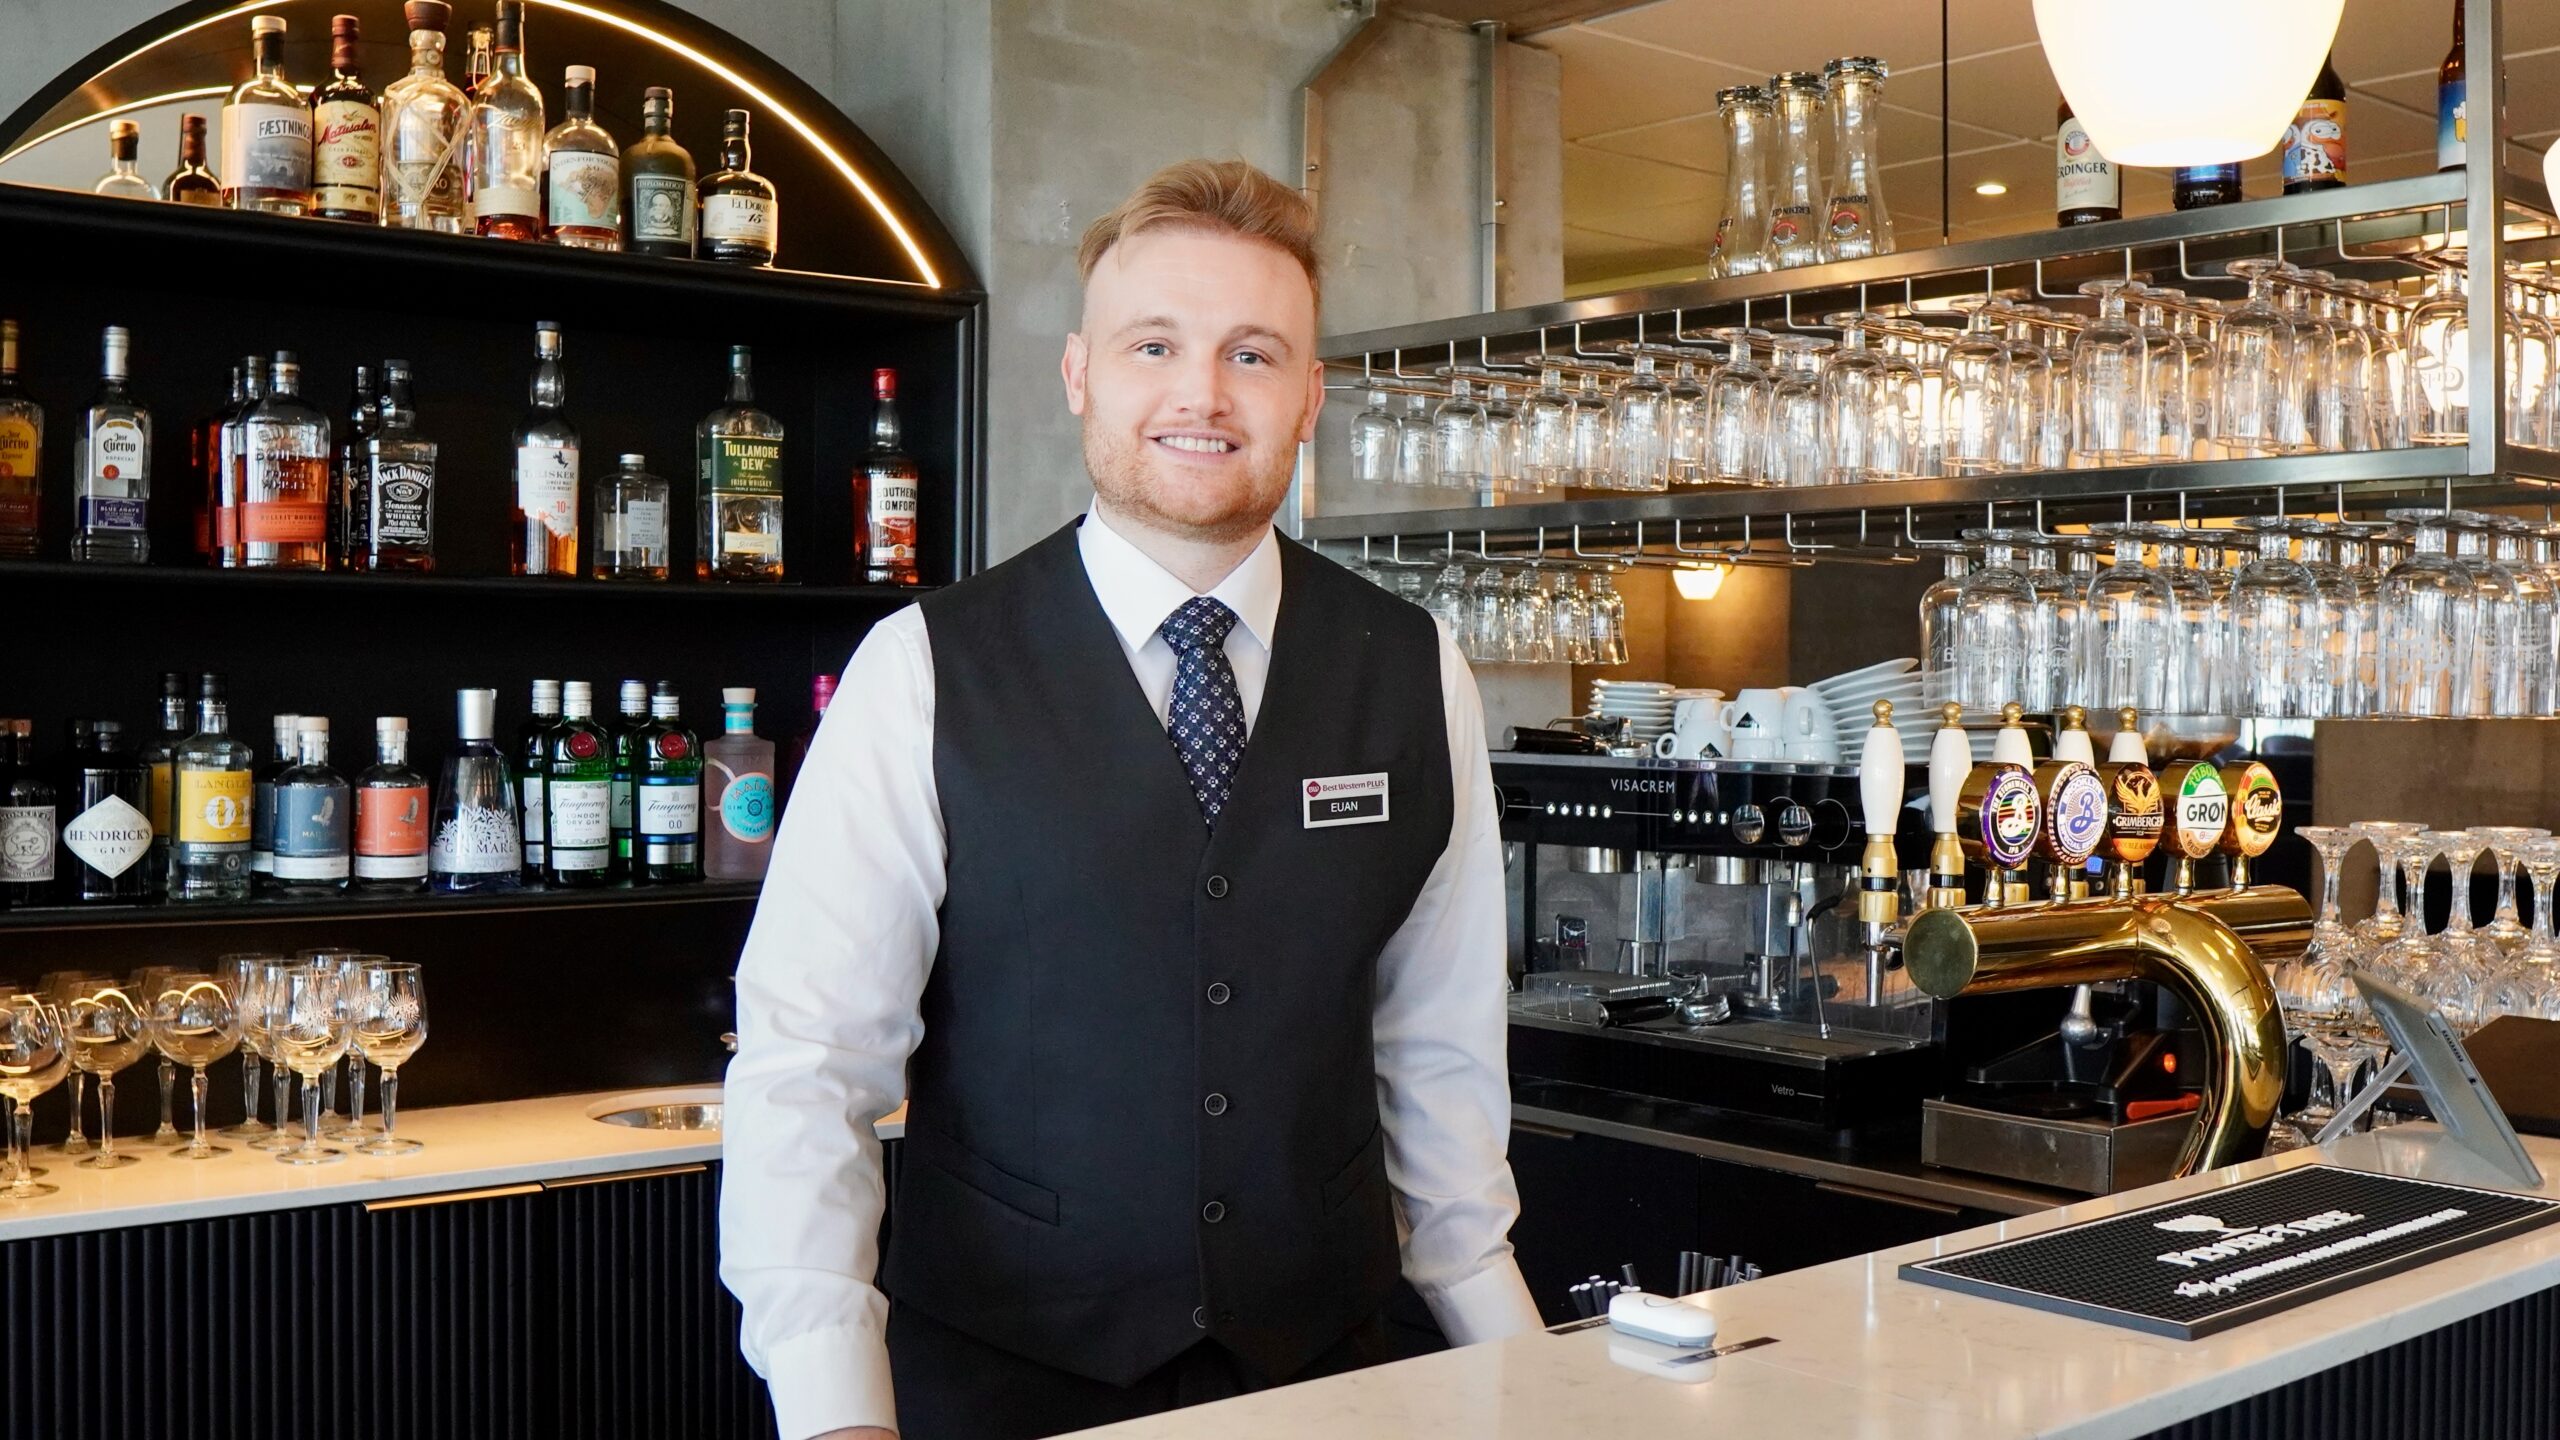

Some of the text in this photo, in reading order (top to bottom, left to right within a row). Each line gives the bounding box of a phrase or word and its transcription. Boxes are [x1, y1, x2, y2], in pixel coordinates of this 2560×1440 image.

[318, 119, 377, 147] Matusalem
[745, 199, 769, 212] DORA
[748, 213, 763, 224] 15
[115, 433, 128, 441] Jose
[103, 438, 136, 453] Cuervo
[723, 440, 779, 459] TULLAMORE
[741, 458, 763, 471] DEW
[377, 468, 399, 486] JACK
[522, 469, 575, 480] TLISKER
[384, 500, 423, 511] Tennessee
[556, 500, 566, 513] 10
[879, 500, 916, 512] COMFORT
[385, 511, 422, 521] WHISKEY
[1322, 784, 1338, 792] Best
[1338, 781, 1366, 790] Western
[1366, 779, 1385, 788] PLUS
[1610, 778, 1675, 794] VISACREM
[558, 798, 607, 811] Tanqueray
[647, 800, 697, 813] Tanqueray
[1330, 801, 1358, 813] EUAN
[2244, 793, 2281, 820] Classic
[668, 820, 682, 829] 0.0
[69, 828, 151, 841] HENDRICK'S
[445, 843, 516, 854] GN MARE
[1771, 1083, 1795, 1097] Vetro
